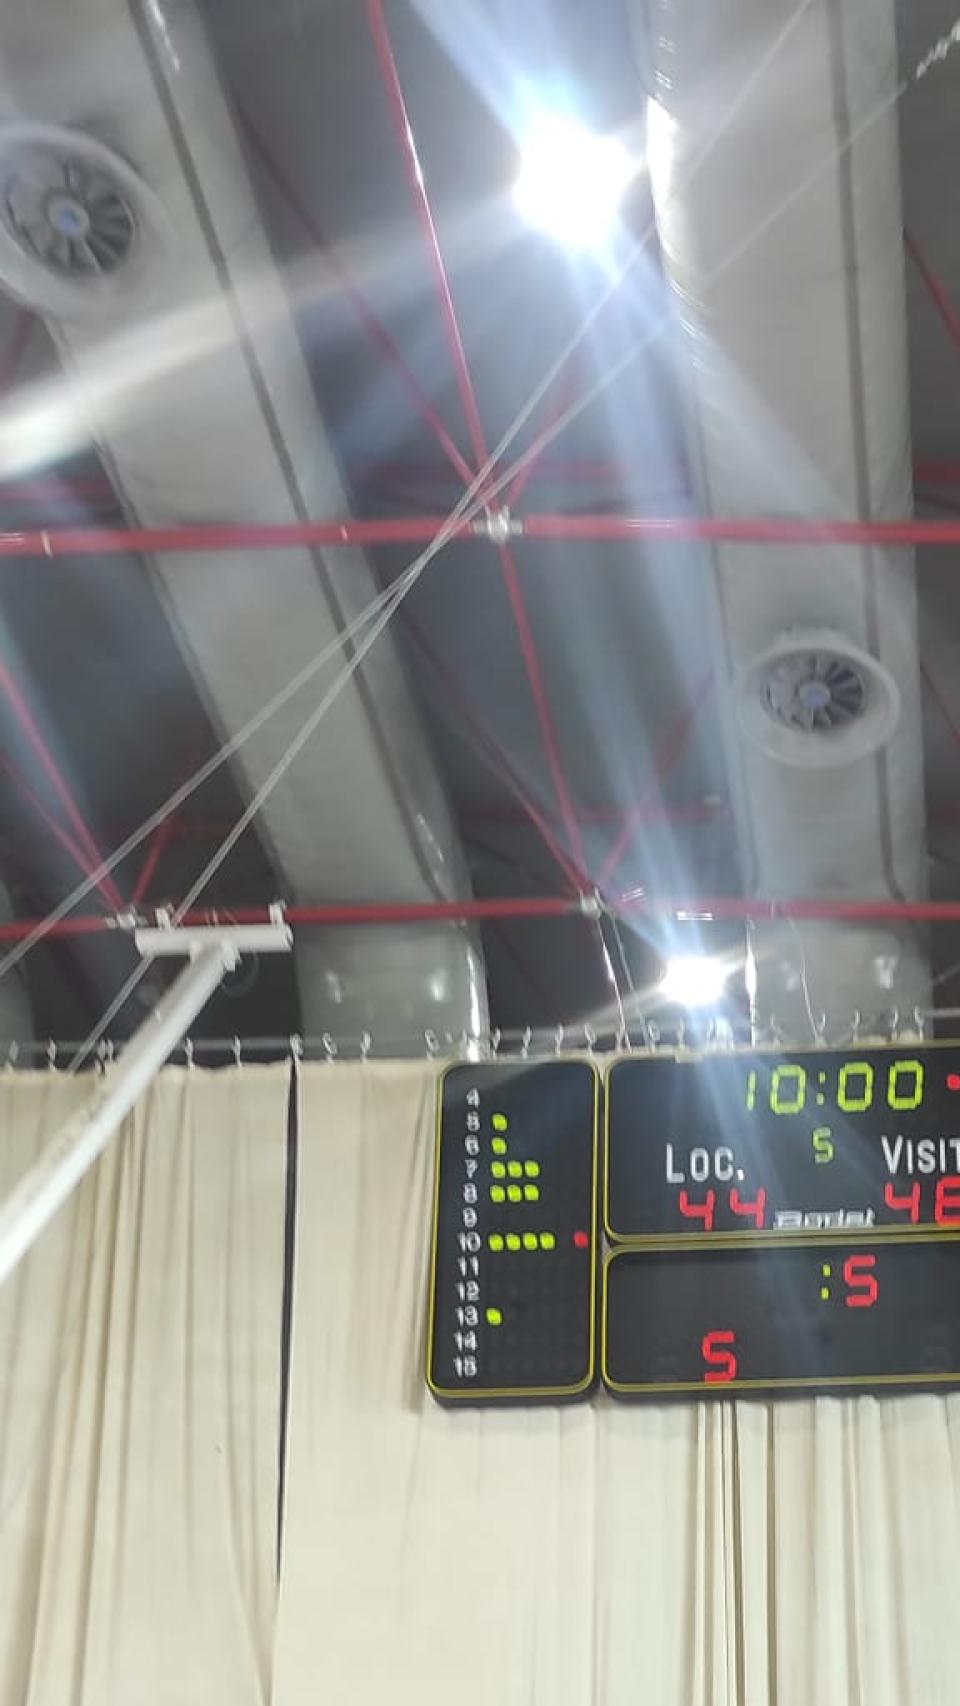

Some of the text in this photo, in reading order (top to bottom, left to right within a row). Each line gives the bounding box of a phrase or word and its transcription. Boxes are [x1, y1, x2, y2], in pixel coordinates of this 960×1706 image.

[466, 1088, 480, 1107] 4
[745, 1060, 924, 1114] 10:00
[467, 1111, 480, 1131] 5
[465, 1134, 480, 1155] 6
[465, 1159, 478, 1178] 7
[666, 1143, 745, 1183] LOC.
[463, 1183, 477, 1204] 8
[463, 1207, 477, 1228] 9
[679, 1187, 766, 1230] 44
[457, 1231, 481, 1252] 10
[457, 1255, 479, 1276] 11
[455, 1280, 480, 1301] 12
[455, 1305, 479, 1327] 13
[453, 1330, 478, 1351] 14
[453, 1355, 477, 1378] 15
